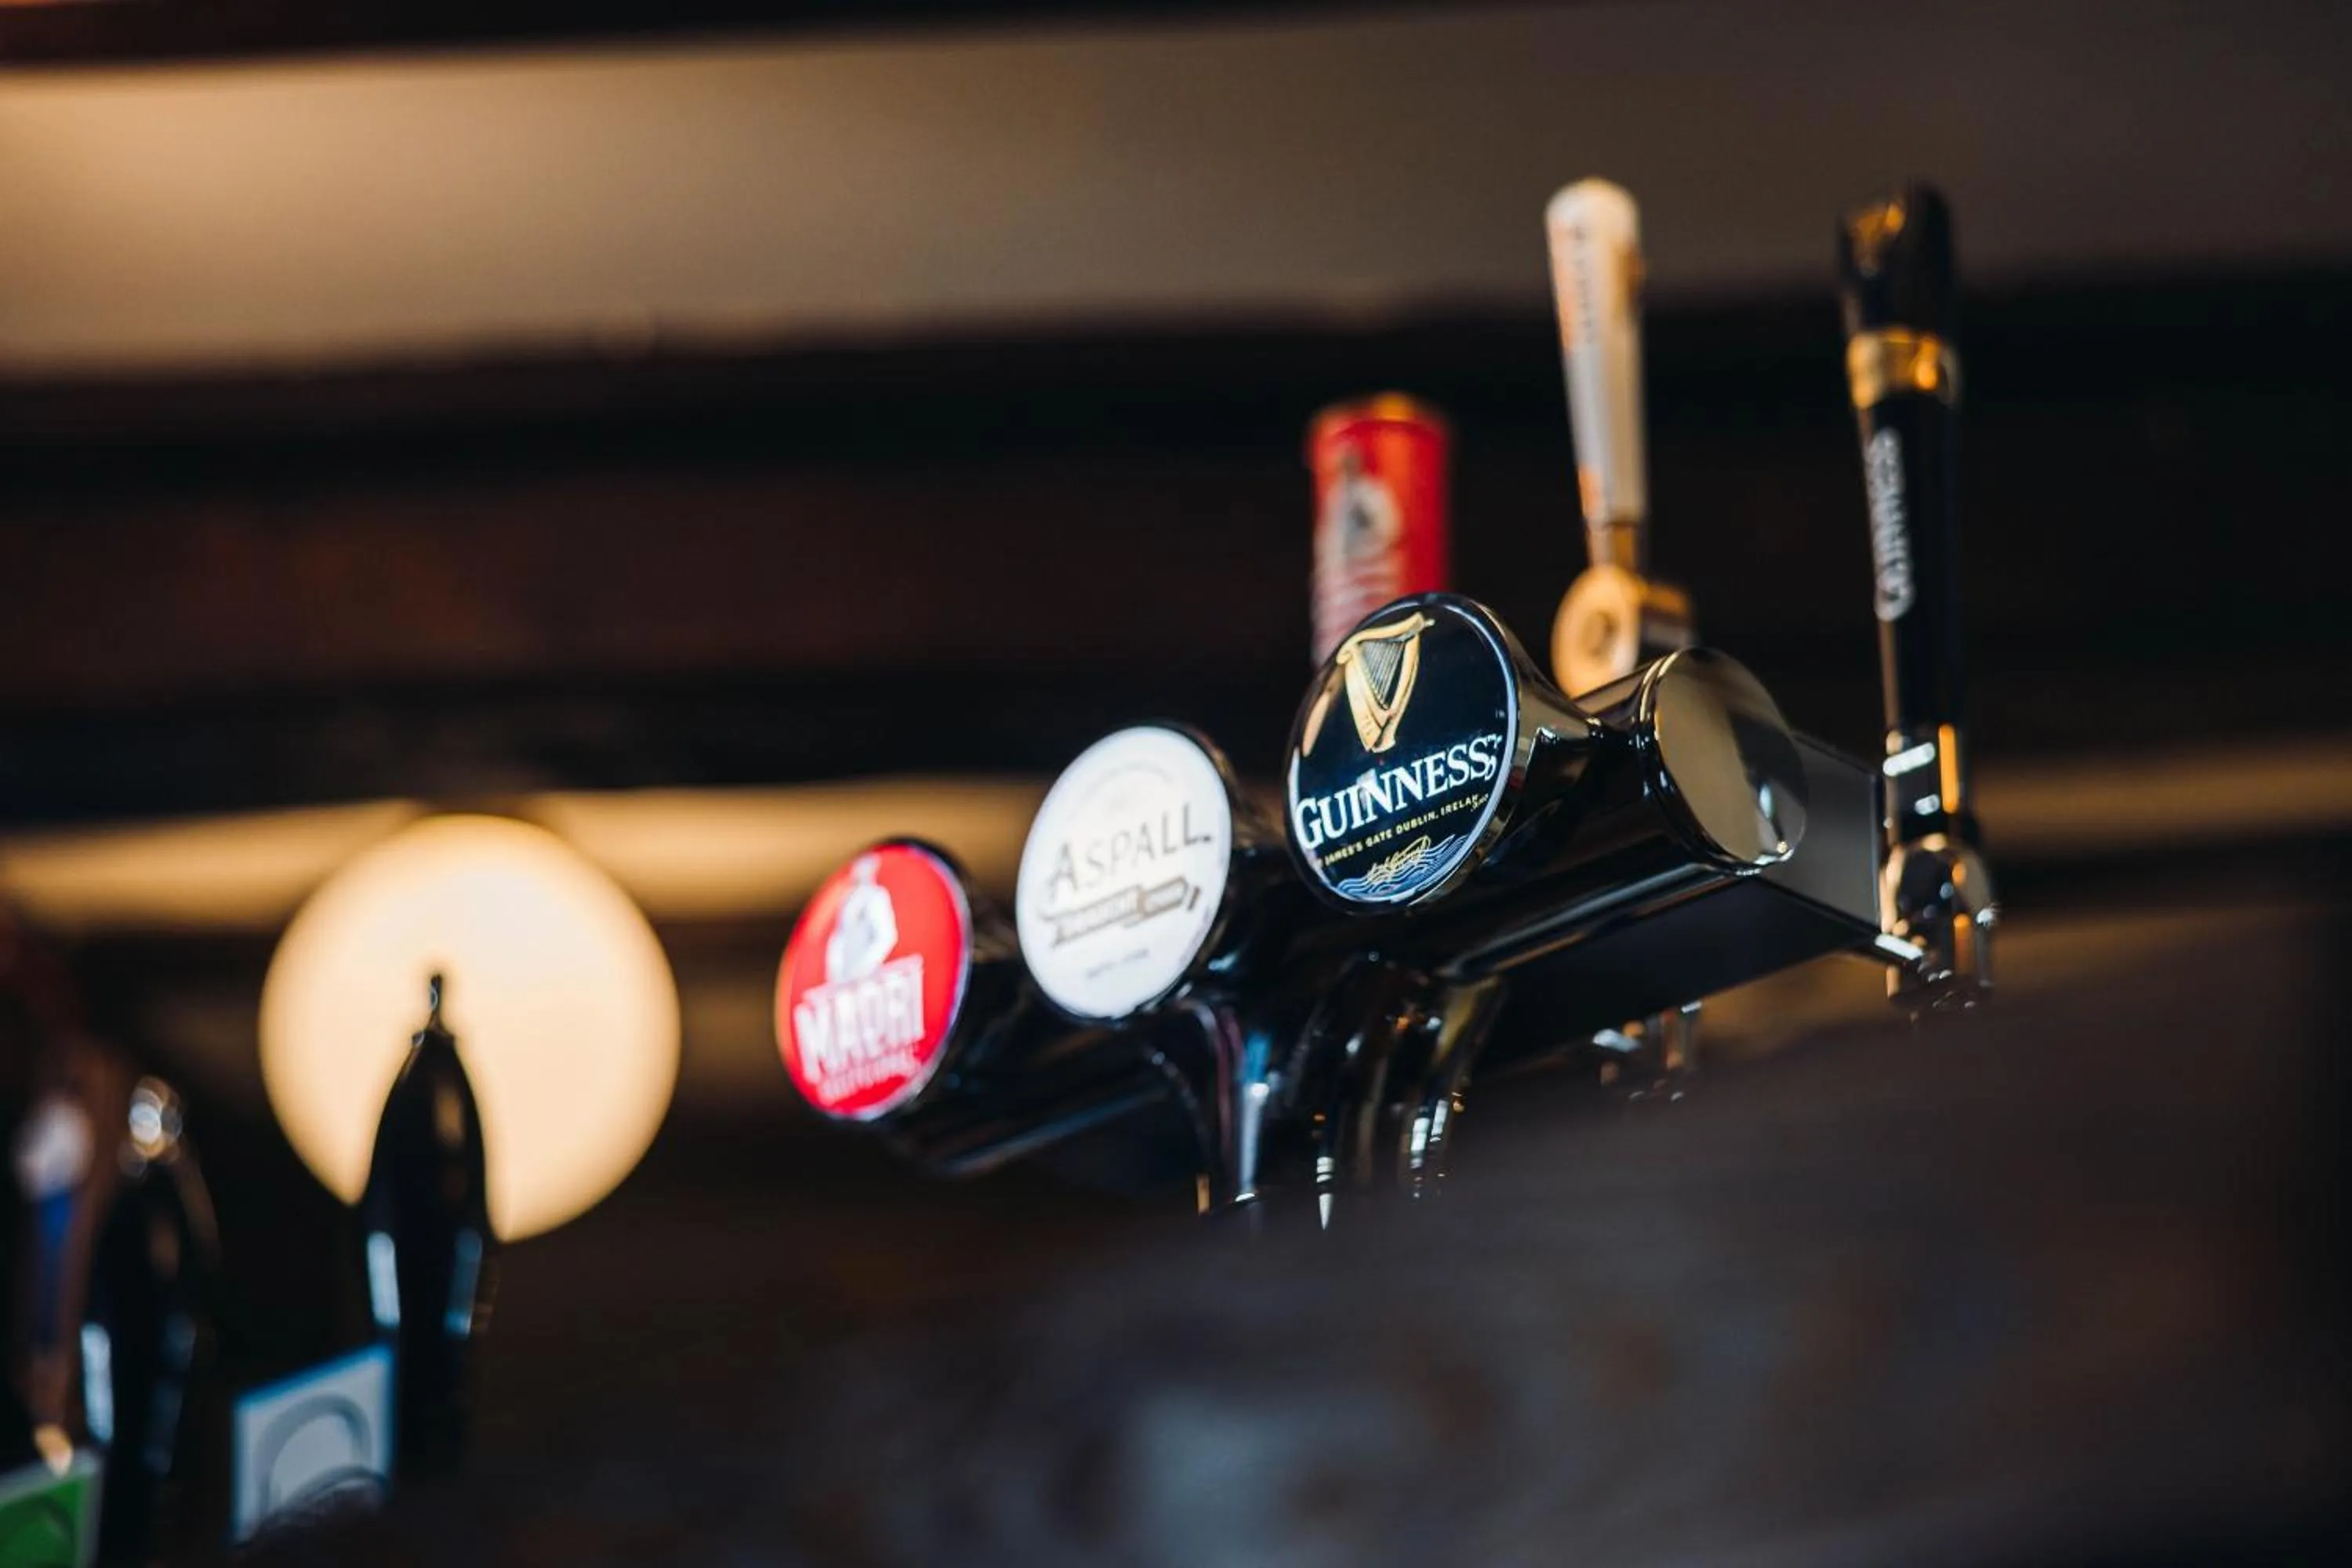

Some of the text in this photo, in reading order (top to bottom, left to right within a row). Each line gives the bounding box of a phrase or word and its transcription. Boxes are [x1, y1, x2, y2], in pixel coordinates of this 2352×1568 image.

[1295, 735, 1496, 850] GUINNESS
[1366, 829, 1392, 848] GATE
[1440, 793, 1488, 816] IRELA
[1047, 801, 1212, 902] ASPALL
